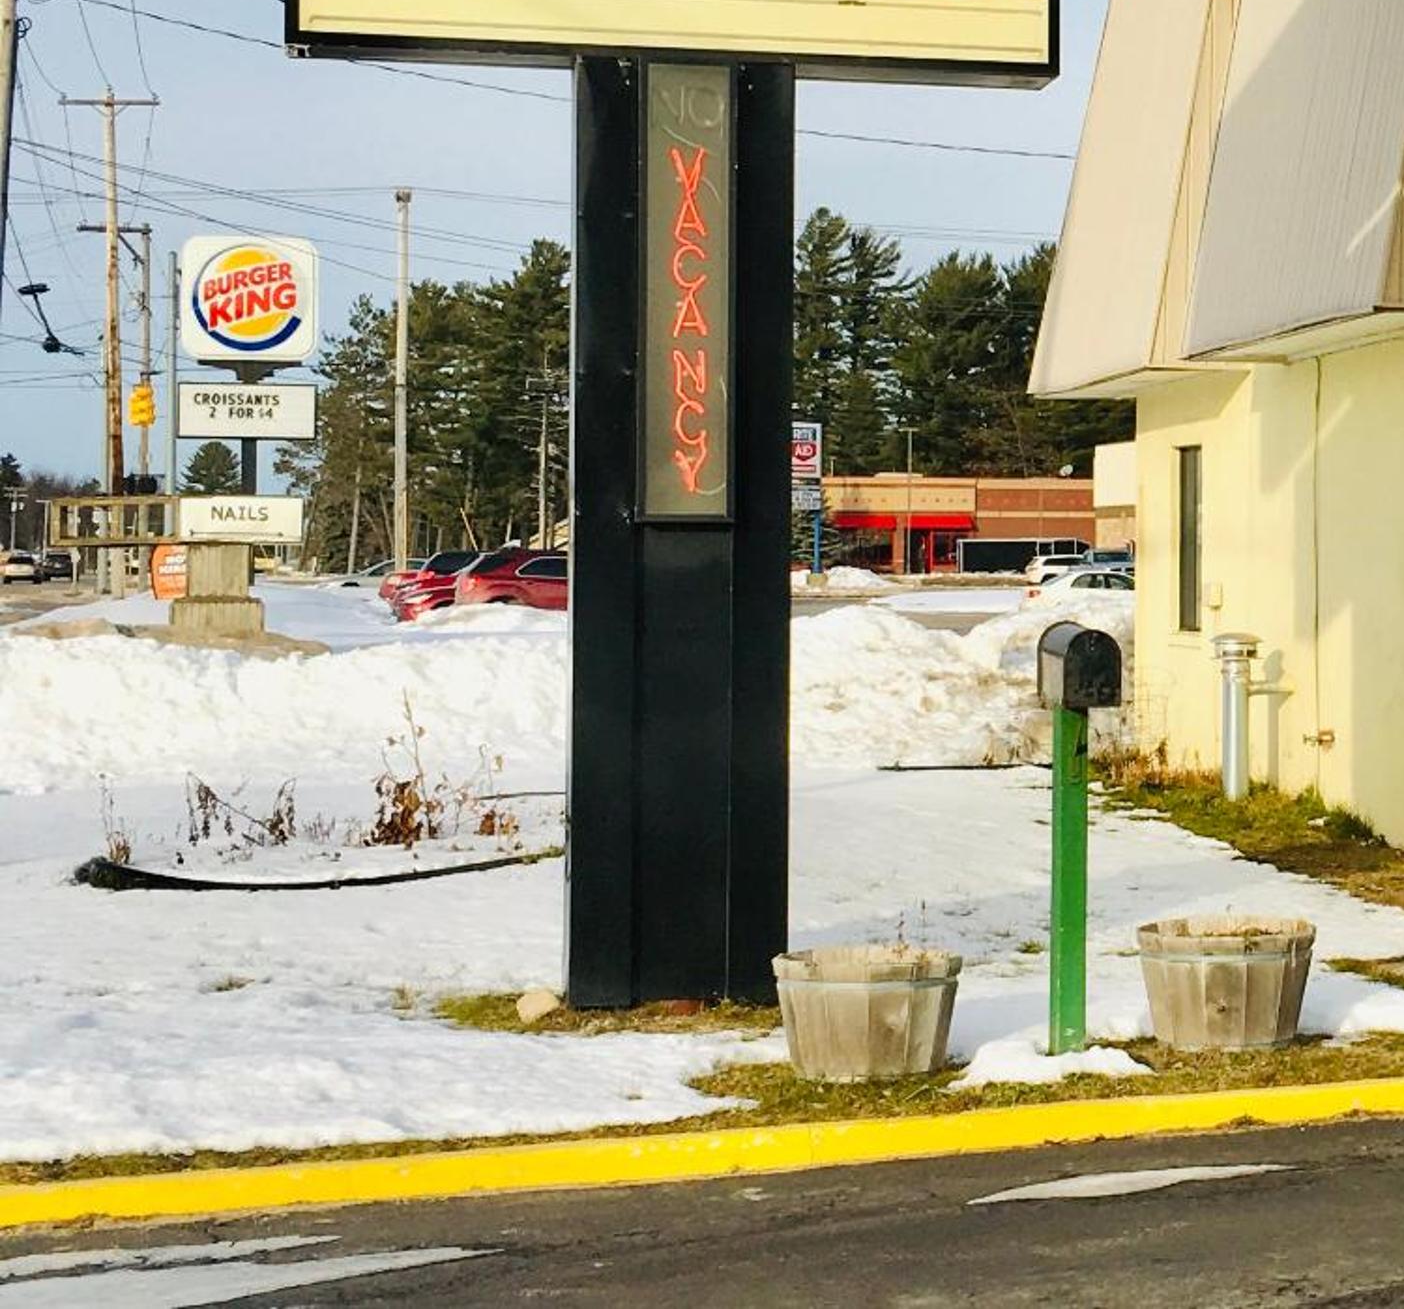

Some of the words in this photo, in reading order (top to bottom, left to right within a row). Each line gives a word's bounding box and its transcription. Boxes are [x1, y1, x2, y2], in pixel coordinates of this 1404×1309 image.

[204, 263, 293, 302] BURGER
[209, 283, 297, 328] KING
[672, 147, 708, 493] VACANCY
[193, 392, 280, 406] CROISSANTS
[209, 407, 217, 419] 2
[228, 407, 254, 419] FOR
[210, 505, 269, 522] NAILS
